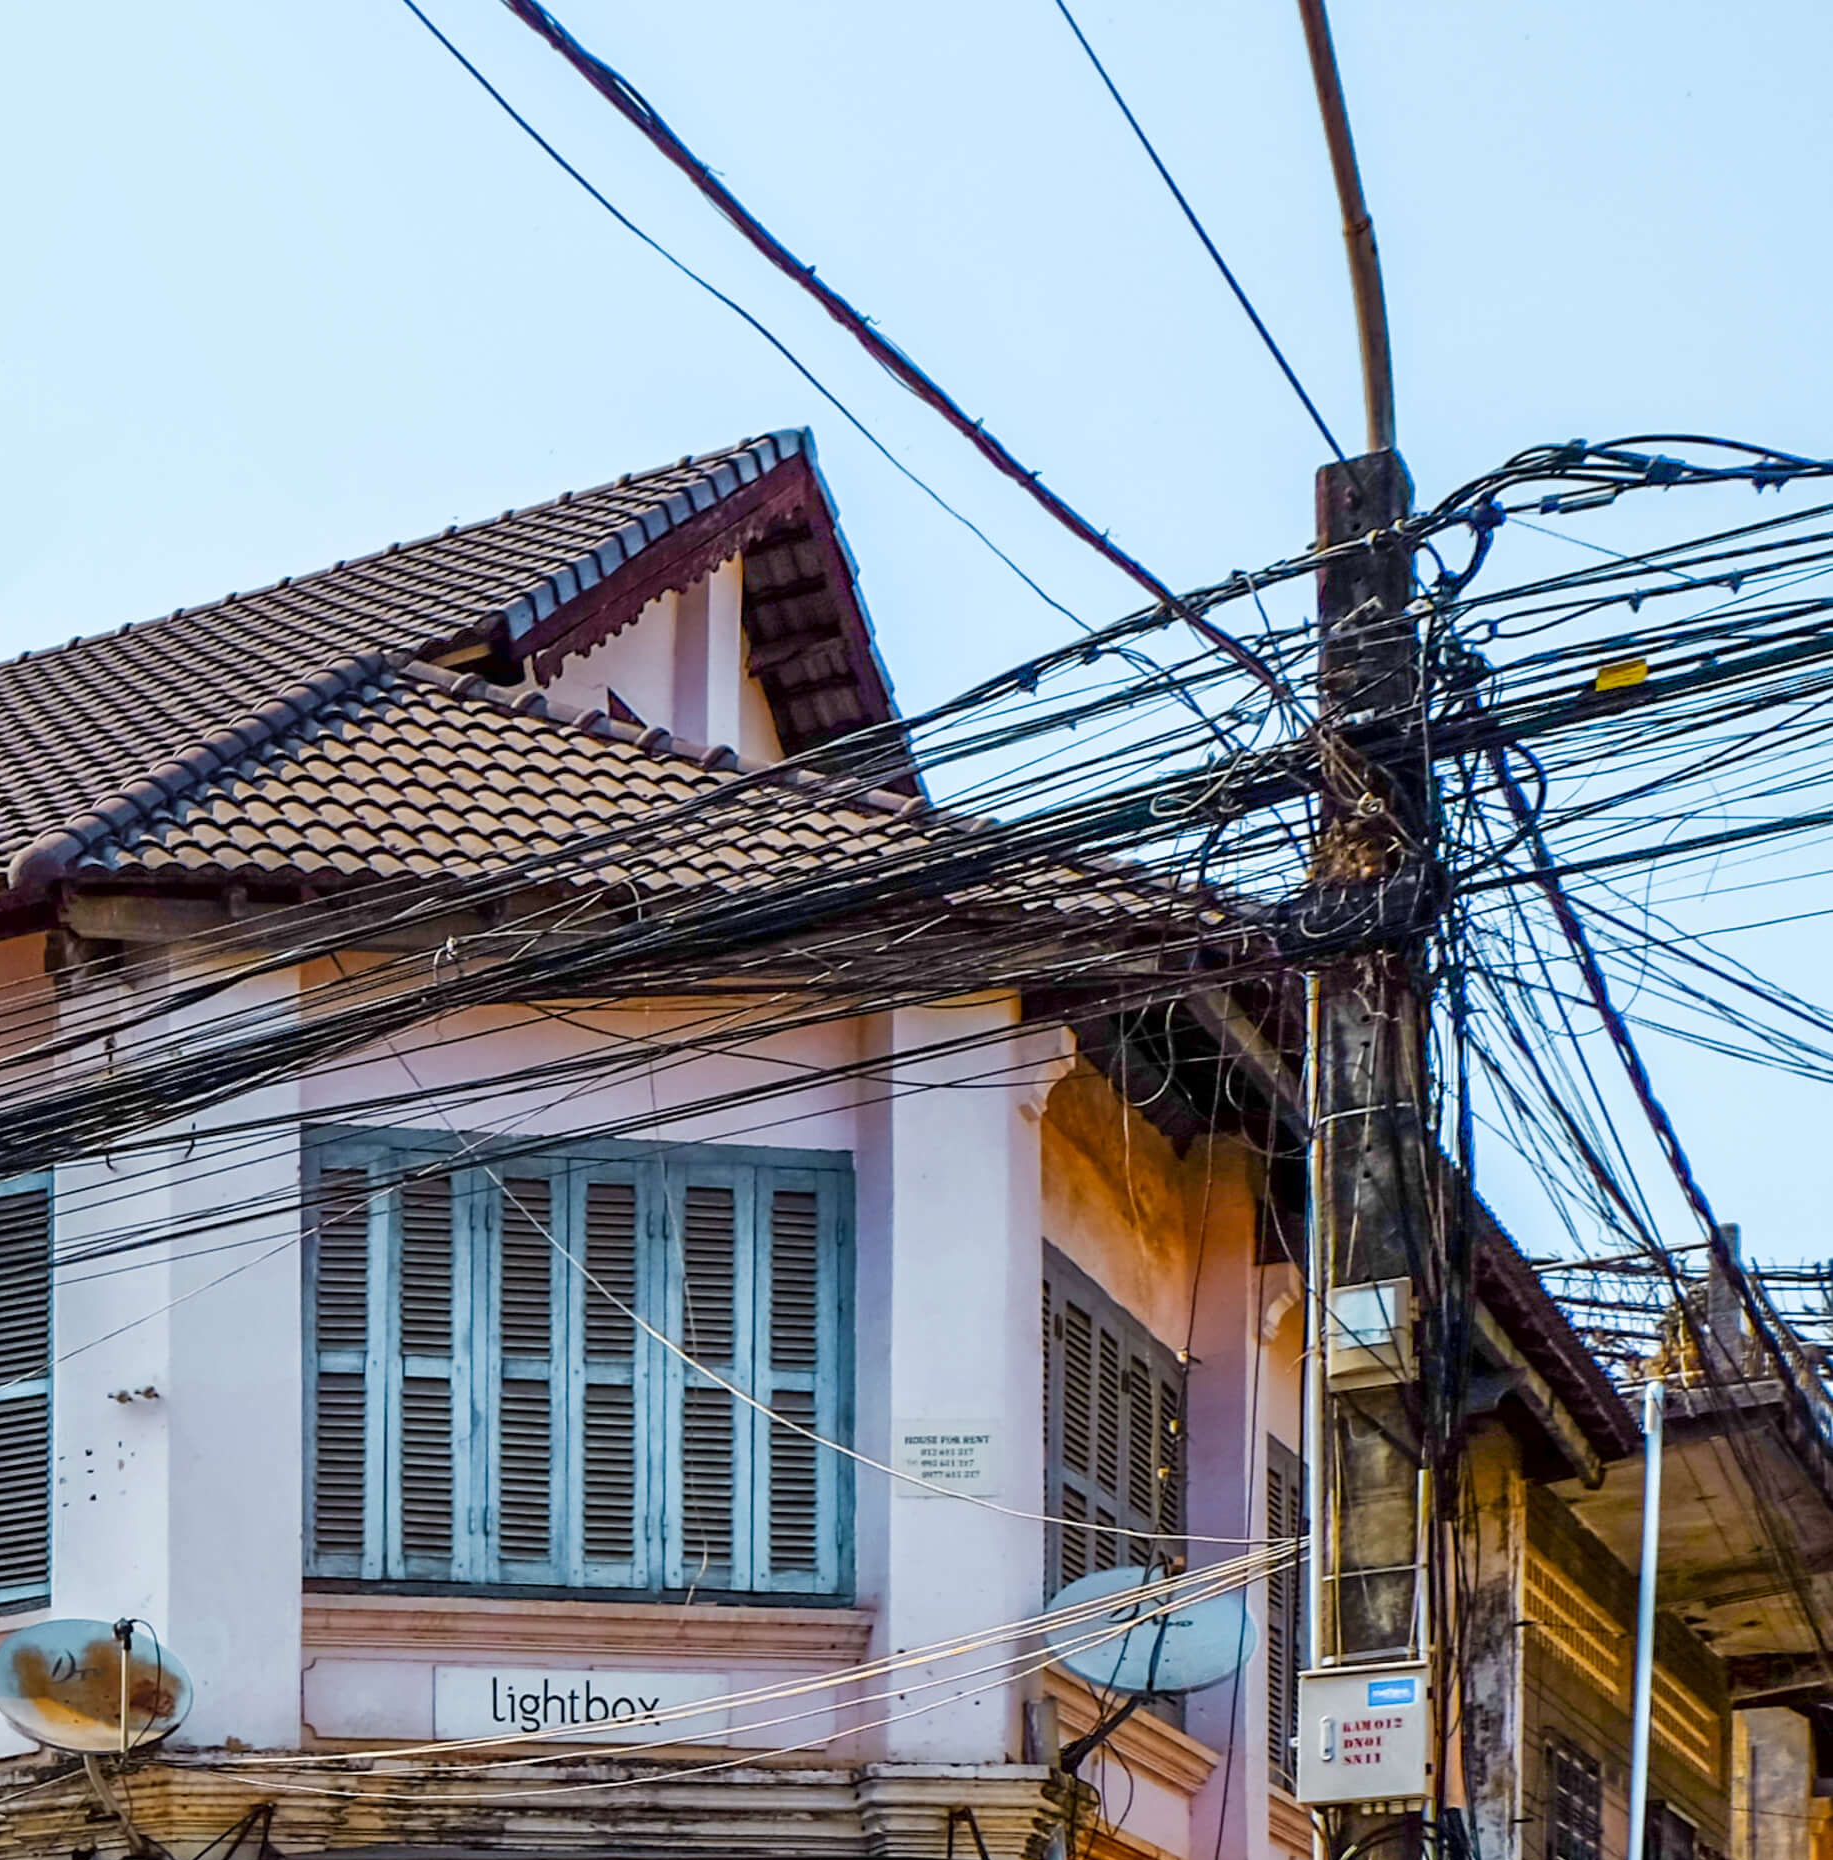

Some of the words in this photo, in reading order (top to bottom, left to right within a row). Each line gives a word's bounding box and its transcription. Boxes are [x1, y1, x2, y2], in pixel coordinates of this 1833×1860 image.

[904, 1435, 938, 1445] HOUSE
[940, 1435, 961, 1444] FOR
[962, 1434, 990, 1444] RENT
[492, 1676, 662, 1733] lightbox
